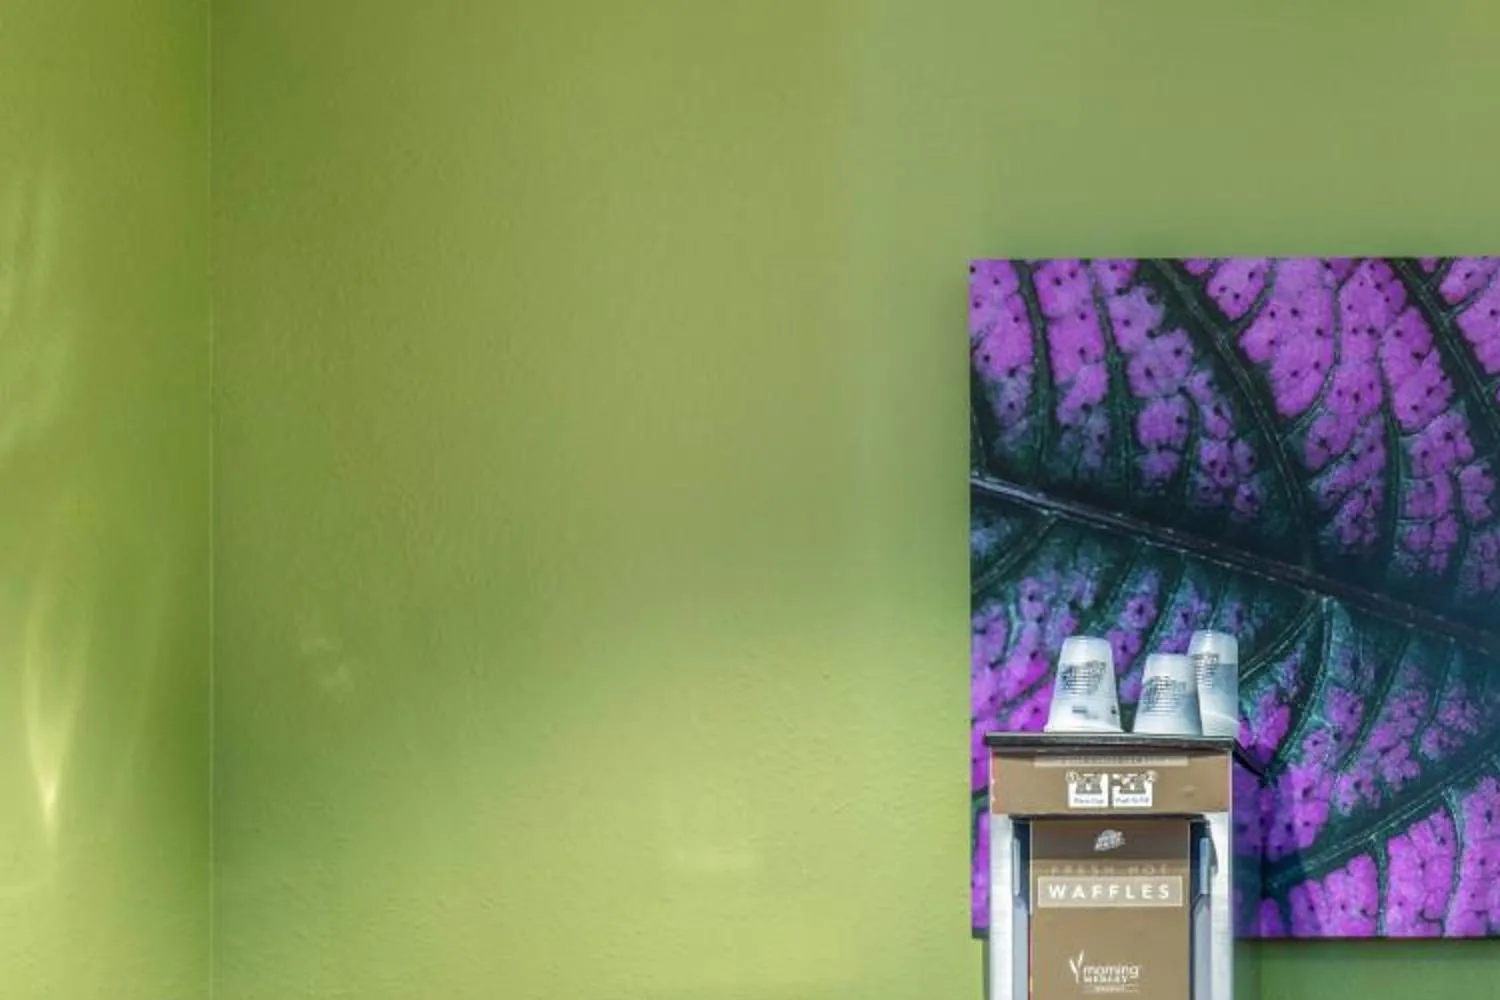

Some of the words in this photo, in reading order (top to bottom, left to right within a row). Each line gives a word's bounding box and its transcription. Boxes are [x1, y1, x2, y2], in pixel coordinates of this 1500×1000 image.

[1051, 864, 1115, 875] FRESH
[1127, 864, 1169, 875] HOT
[1049, 884, 1170, 900] WAFFLES
[1083, 965, 1140, 979] morning
